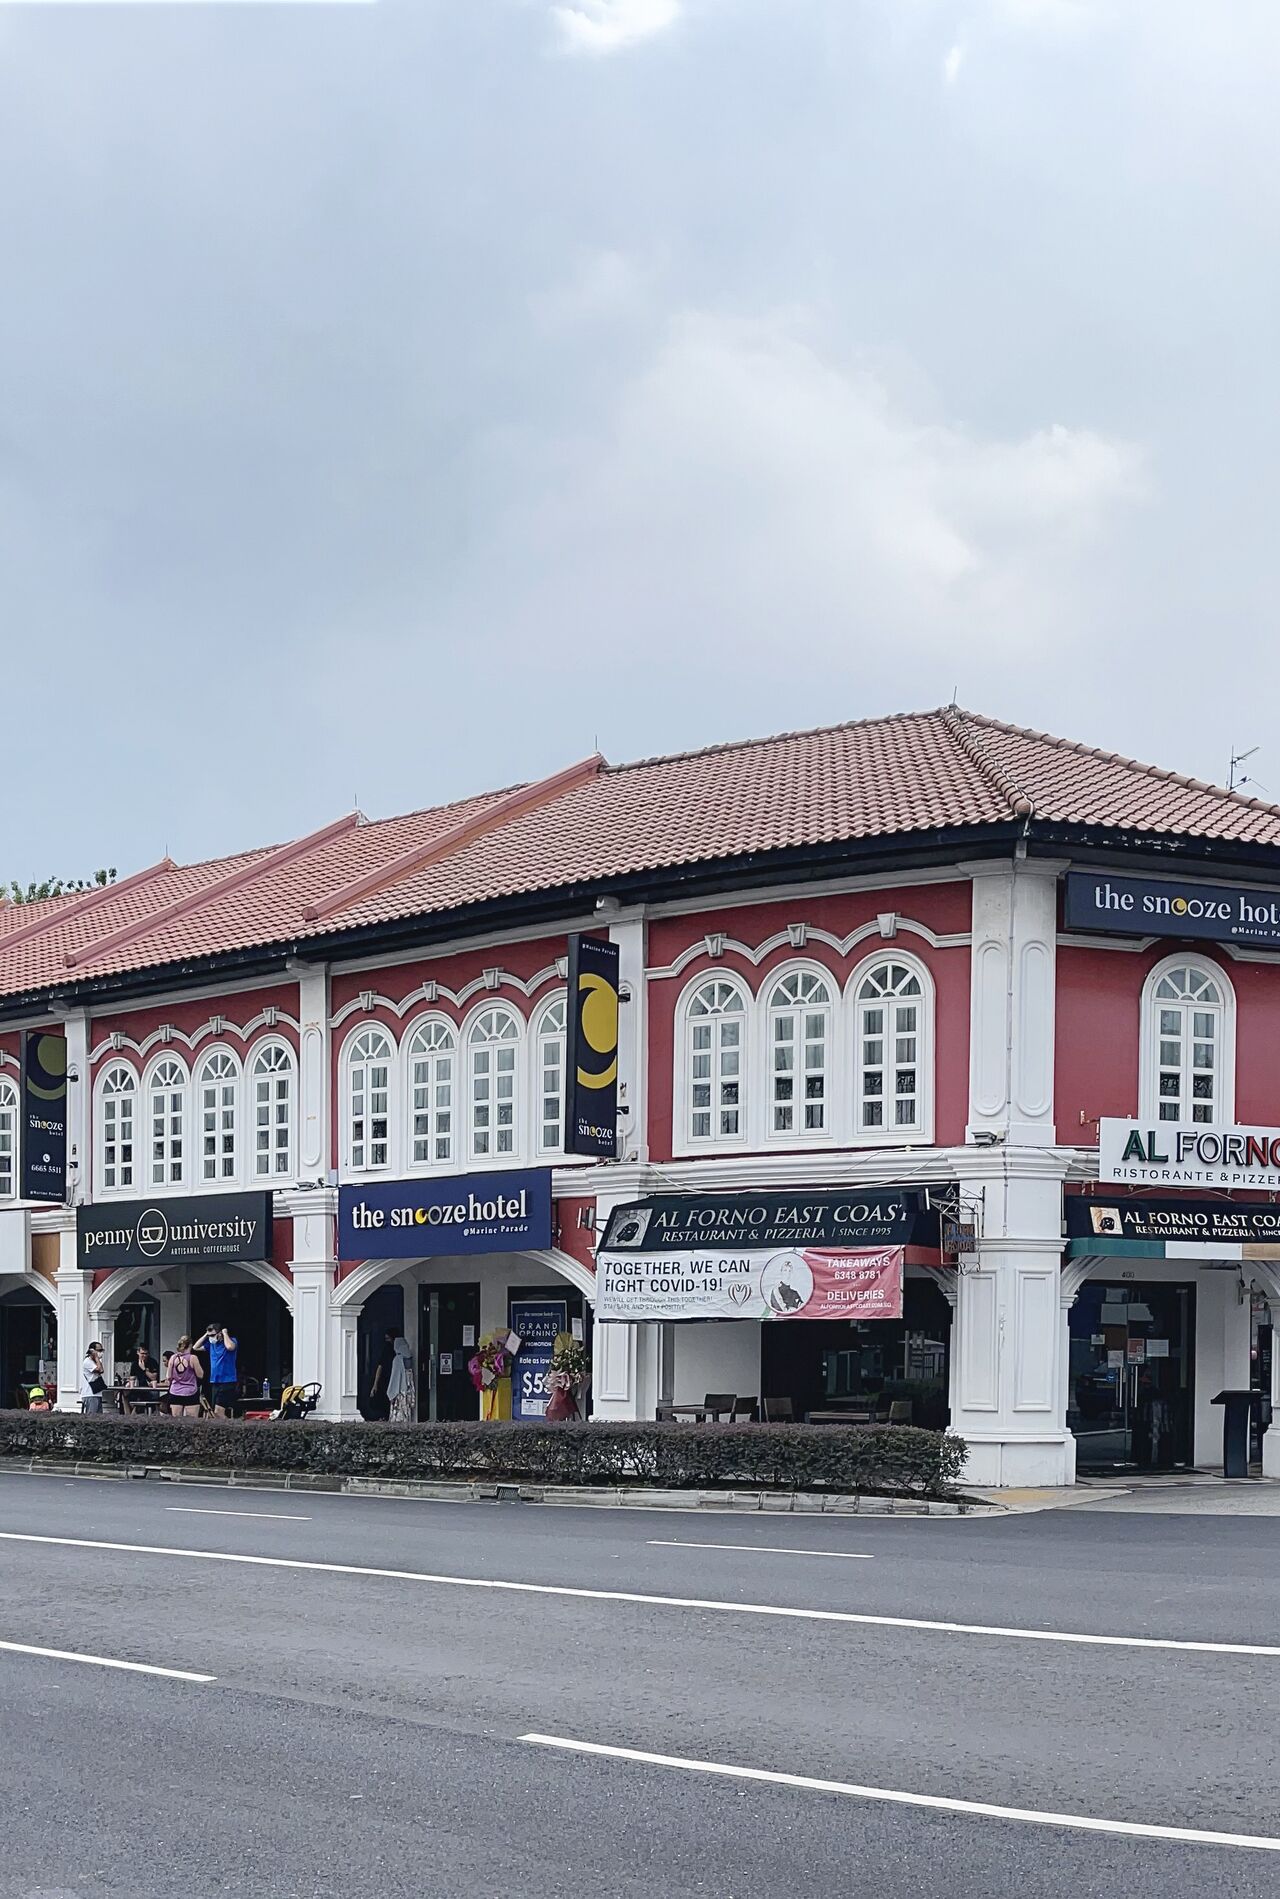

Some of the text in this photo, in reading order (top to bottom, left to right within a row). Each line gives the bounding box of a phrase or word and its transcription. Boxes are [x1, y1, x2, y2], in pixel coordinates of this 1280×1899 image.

[1094, 883, 1134, 912] the
[1143, 894, 1231, 919] snooze
[1231, 926, 1268, 937] @Marine
[29, 1119, 64, 1131] snooze
[578, 1124, 613, 1139] snooze
[1121, 1129, 1168, 1163] AL
[1113, 1167, 1214, 1181] RISTORANTE
[1220, 1173, 1229, 1181] &
[352, 1189, 527, 1229] the snooze hotel
[653, 1211, 680, 1228] AL
[685, 1207, 767, 1227] FORNO
[774, 1205, 829, 1224] EAST
[1124, 1212, 1144, 1224] AL
[1149, 1212, 1208, 1226] FORNO
[1212, 1213, 1248, 1227] EAST
[84, 1215, 257, 1254] penny university
[463, 1224, 529, 1237] @Marine Parade
[661, 1227, 892, 1242] RESTAURANT & PIZZERIA SINCE 1995
[1135, 1225, 1199, 1236] RESTAURANT
[1202, 1227, 1210, 1236] &
[1212, 1228, 1256, 1237] PIZZERIA
[171, 1244, 240, 1255] ARTISANAL COFFEEHOUSE
[604, 1259, 750, 1276] TOGETHER, WE CAN
[827, 1256, 891, 1268] TAKEAWAYS
[834, 1270, 881, 1280] 6348 8781
[605, 1277, 723, 1293] FIGHT COVID-19!
[827, 1289, 885, 1301] DELIVERIES
[519, 1322, 558, 1330] GRAND
[519, 1329, 558, 1337] OPENING
